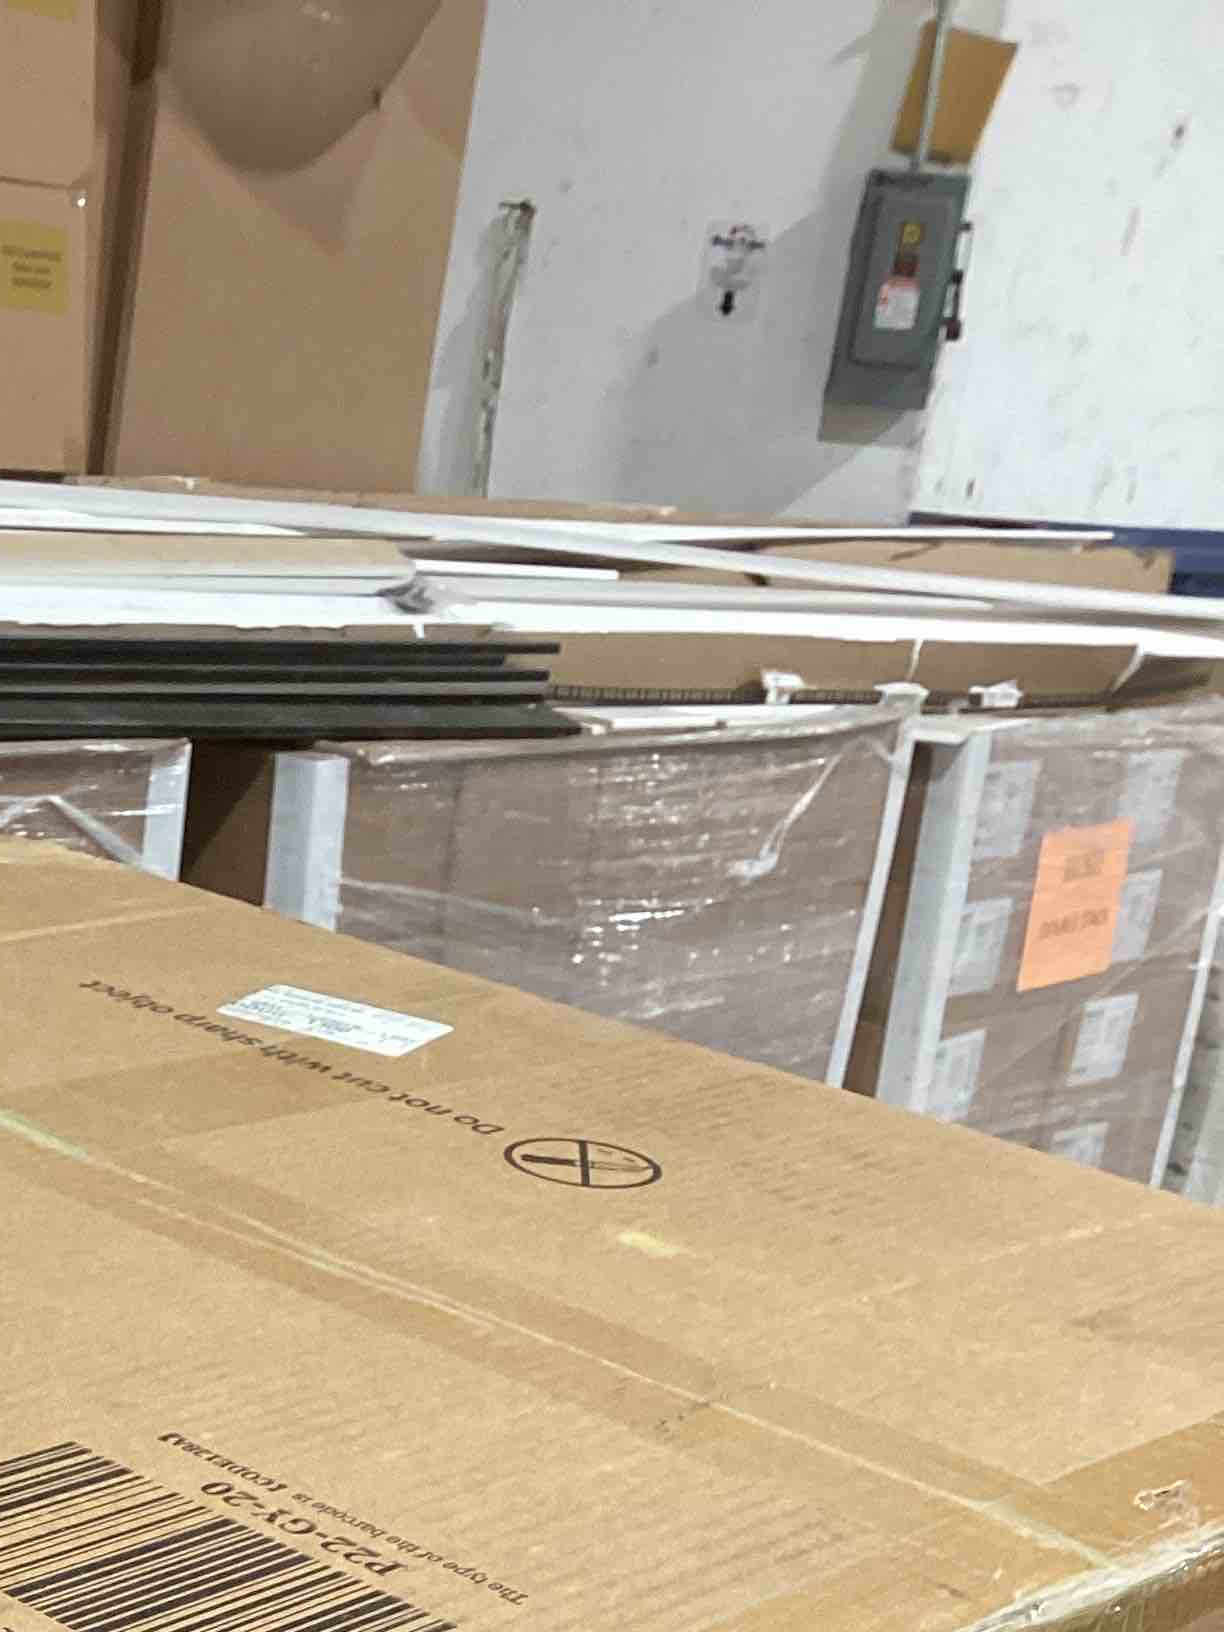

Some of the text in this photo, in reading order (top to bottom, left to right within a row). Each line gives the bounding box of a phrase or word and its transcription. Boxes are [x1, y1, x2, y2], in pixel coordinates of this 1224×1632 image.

[78, 979, 174, 1017] object
[174, 1011, 261, 1051] sharp
[259, 1043, 332, 1075] with
[331, 1071, 390, 1096] cut
[388, 1091, 452, 1117] not
[453, 1111, 505, 1136] Do
[289, 1492, 313, 1507] is
[199, 1480, 409, 1577] P22-GY-20
[309, 1500, 388, 1540] barcode
[384, 1535, 421, 1557] the
[418, 1550, 444, 1565] of
[441, 1559, 489, 1586] type
[487, 1581, 530, 1606] The
